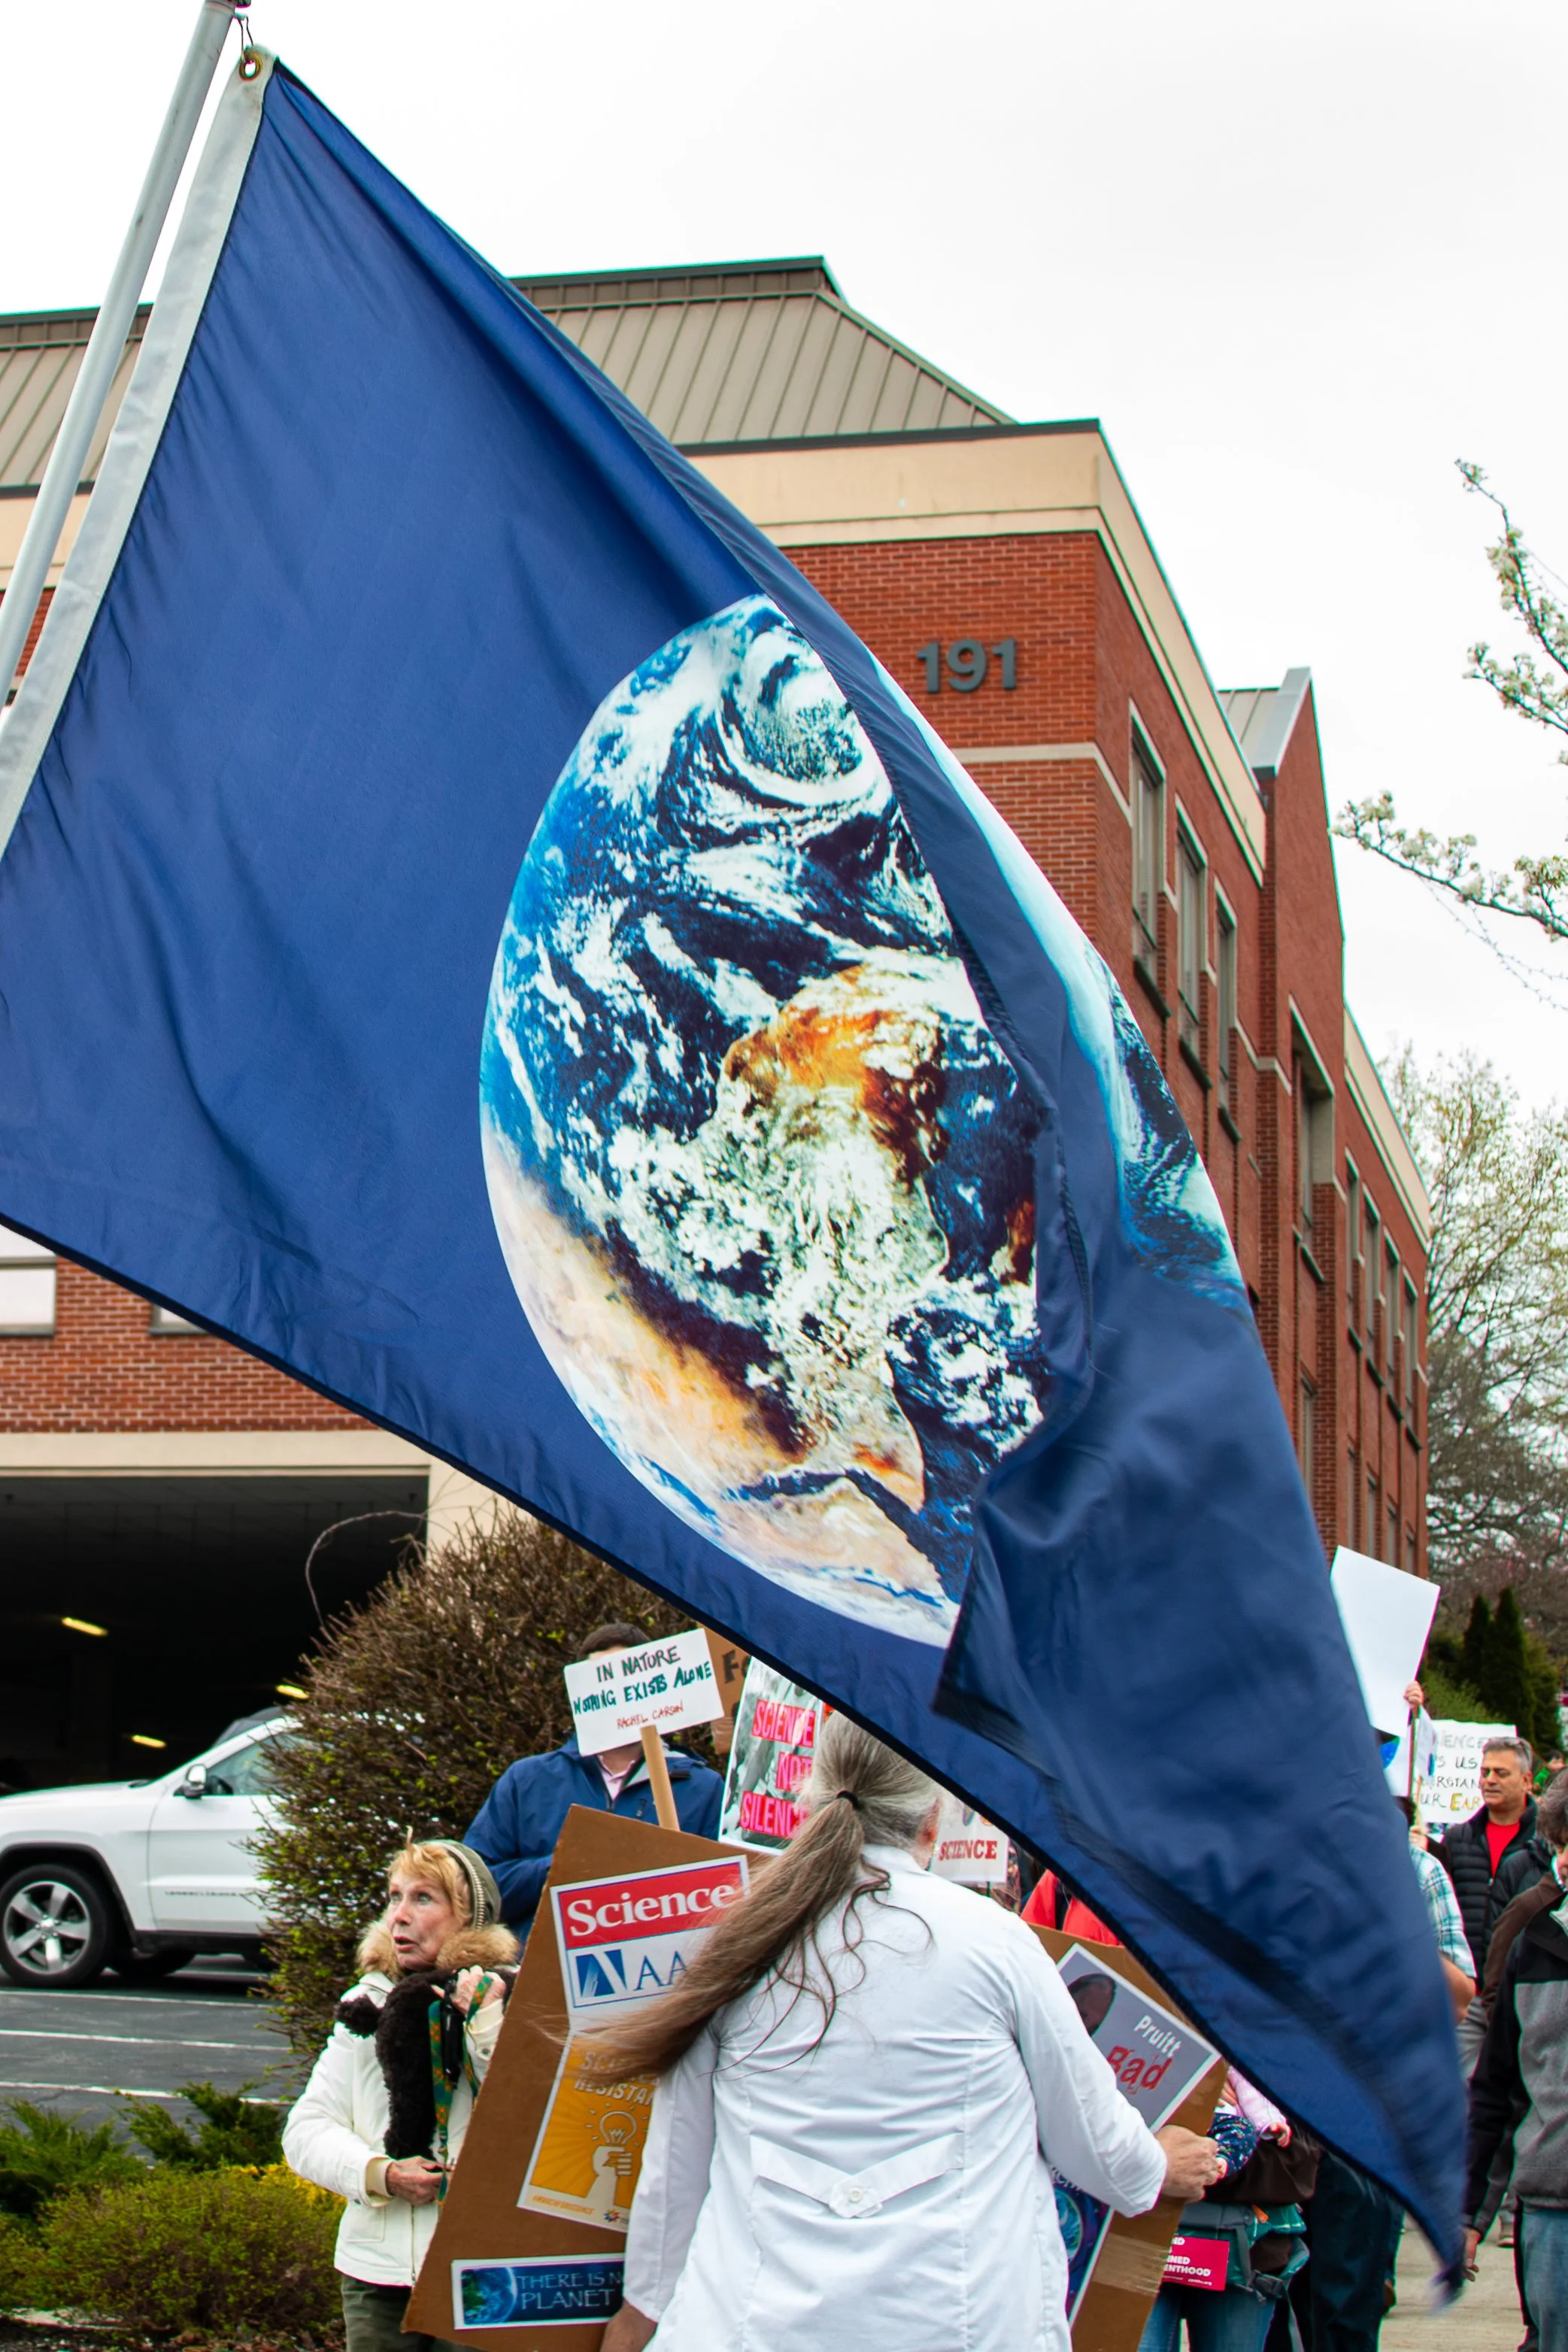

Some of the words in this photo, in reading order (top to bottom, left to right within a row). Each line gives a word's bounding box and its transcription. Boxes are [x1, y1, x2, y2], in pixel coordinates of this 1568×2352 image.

[917, 638, 1017, 693] 191
[596, 1662, 614, 1683] IN
[621, 1646, 681, 1677] NATURE
[673, 1660, 713, 1688] ALONE
[616, 1710, 649, 1730] RACHEL
[652, 1700, 684, 1719] CARSON
[753, 1701, 816, 1747] SCIENCE
[777, 1752, 814, 1792] NOT
[1450, 1792, 1482, 1811] EAR
[939, 1839, 998, 1861] SCIENCE
[567, 1883, 738, 1937] Science
[633, 1950, 688, 1992] AA
[1133, 2014, 1182, 2059] Pruitt
[1106, 2045, 1173, 2092] Bad
[516, 2272, 584, 2290] THERE
[587, 2272, 605, 2287] IS
[608, 2271, 622, 2285] N
[521, 2288, 615, 2310] PLANET
